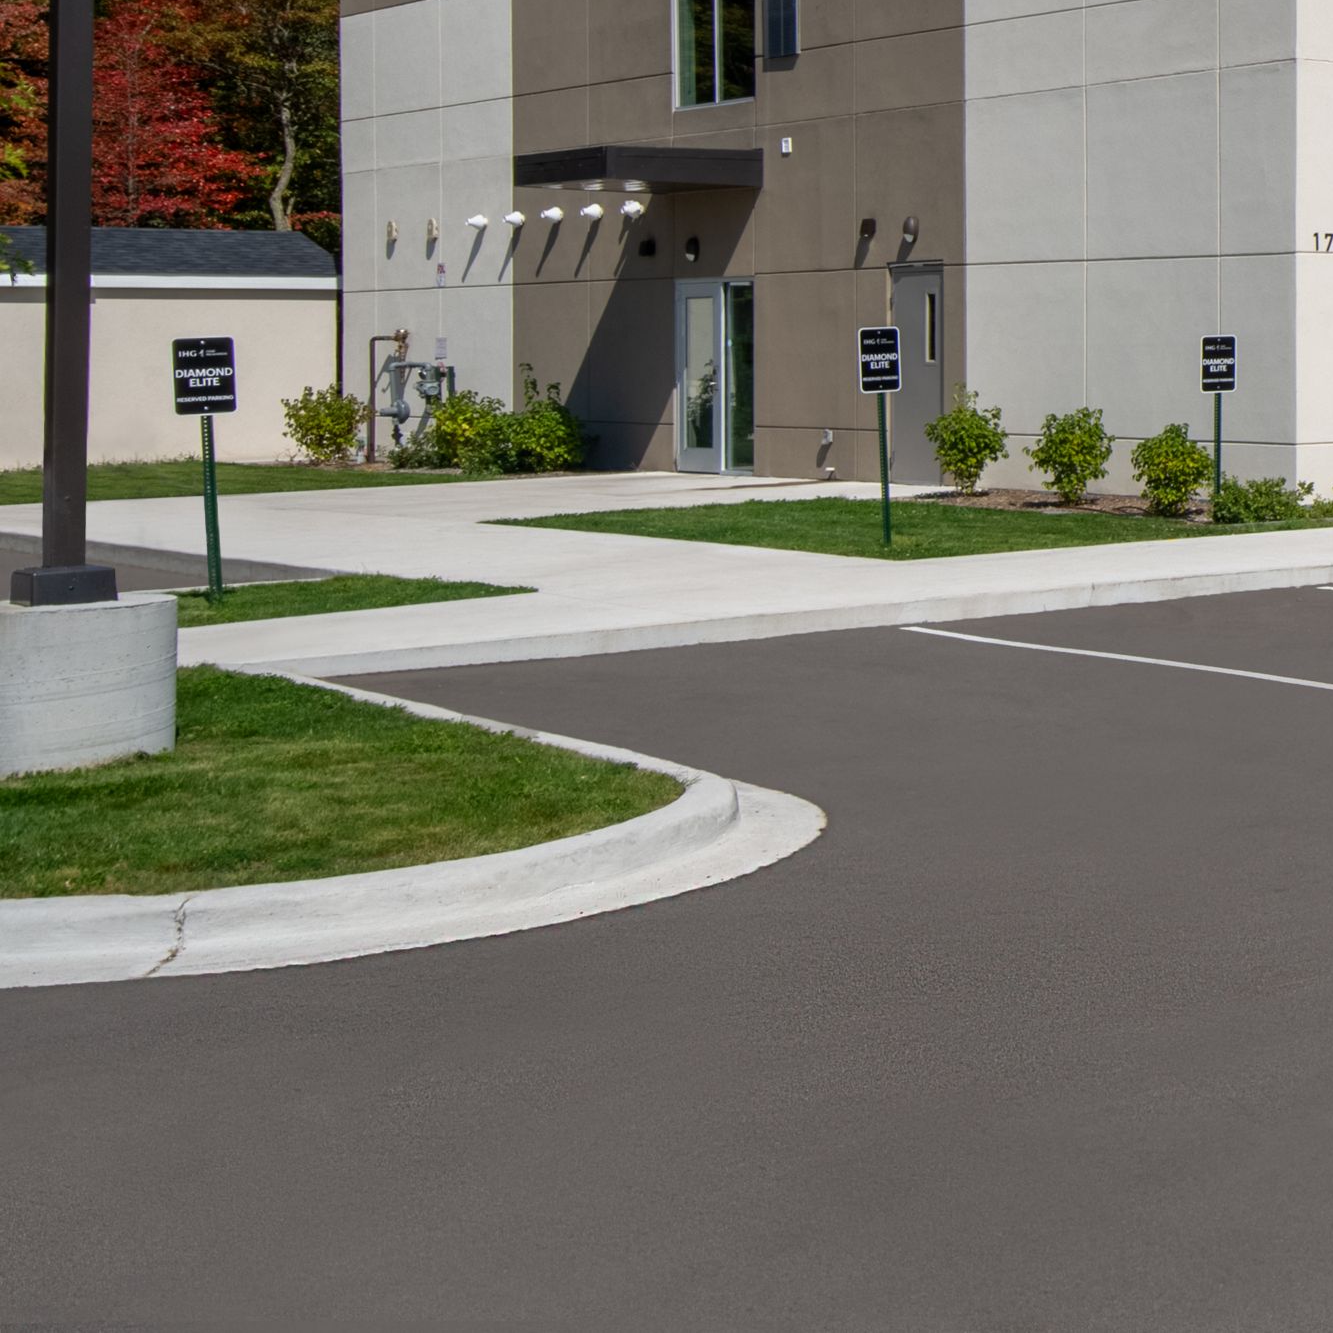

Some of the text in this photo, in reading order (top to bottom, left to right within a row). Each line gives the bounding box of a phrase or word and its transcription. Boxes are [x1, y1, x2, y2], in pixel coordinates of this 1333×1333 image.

[178, 350, 197, 358] IHG
[861, 353, 898, 362] DIAMOND
[870, 361, 890, 370] ELITE
[1202, 358, 1235, 366] DIAMOND
[175, 367, 234, 378] DIAMOND
[189, 377, 221, 388] ELITE
